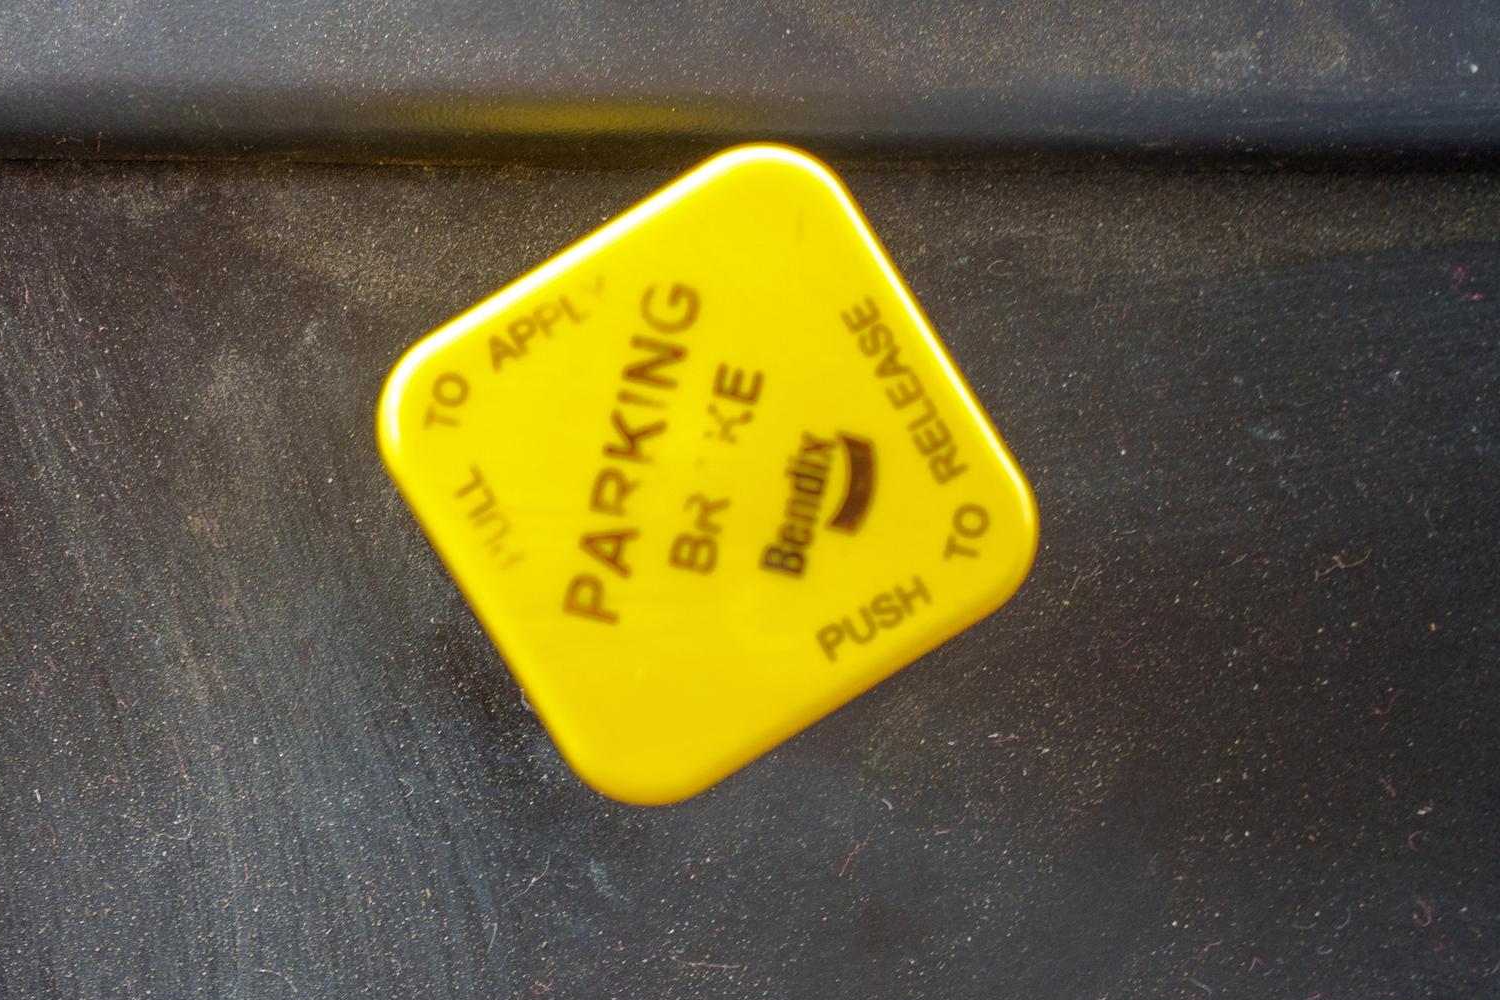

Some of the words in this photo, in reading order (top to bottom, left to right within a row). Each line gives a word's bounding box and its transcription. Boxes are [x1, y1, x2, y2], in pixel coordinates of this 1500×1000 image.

[423, 372, 470, 430] TO
[562, 280, 701, 626] PARKING
[841, 297, 969, 485] RELEASE
[667, 362, 764, 576] BRKE
[758, 431, 837, 580] Bendix
[942, 503, 990, 562] TO
[815, 577, 933, 662] PUSH
